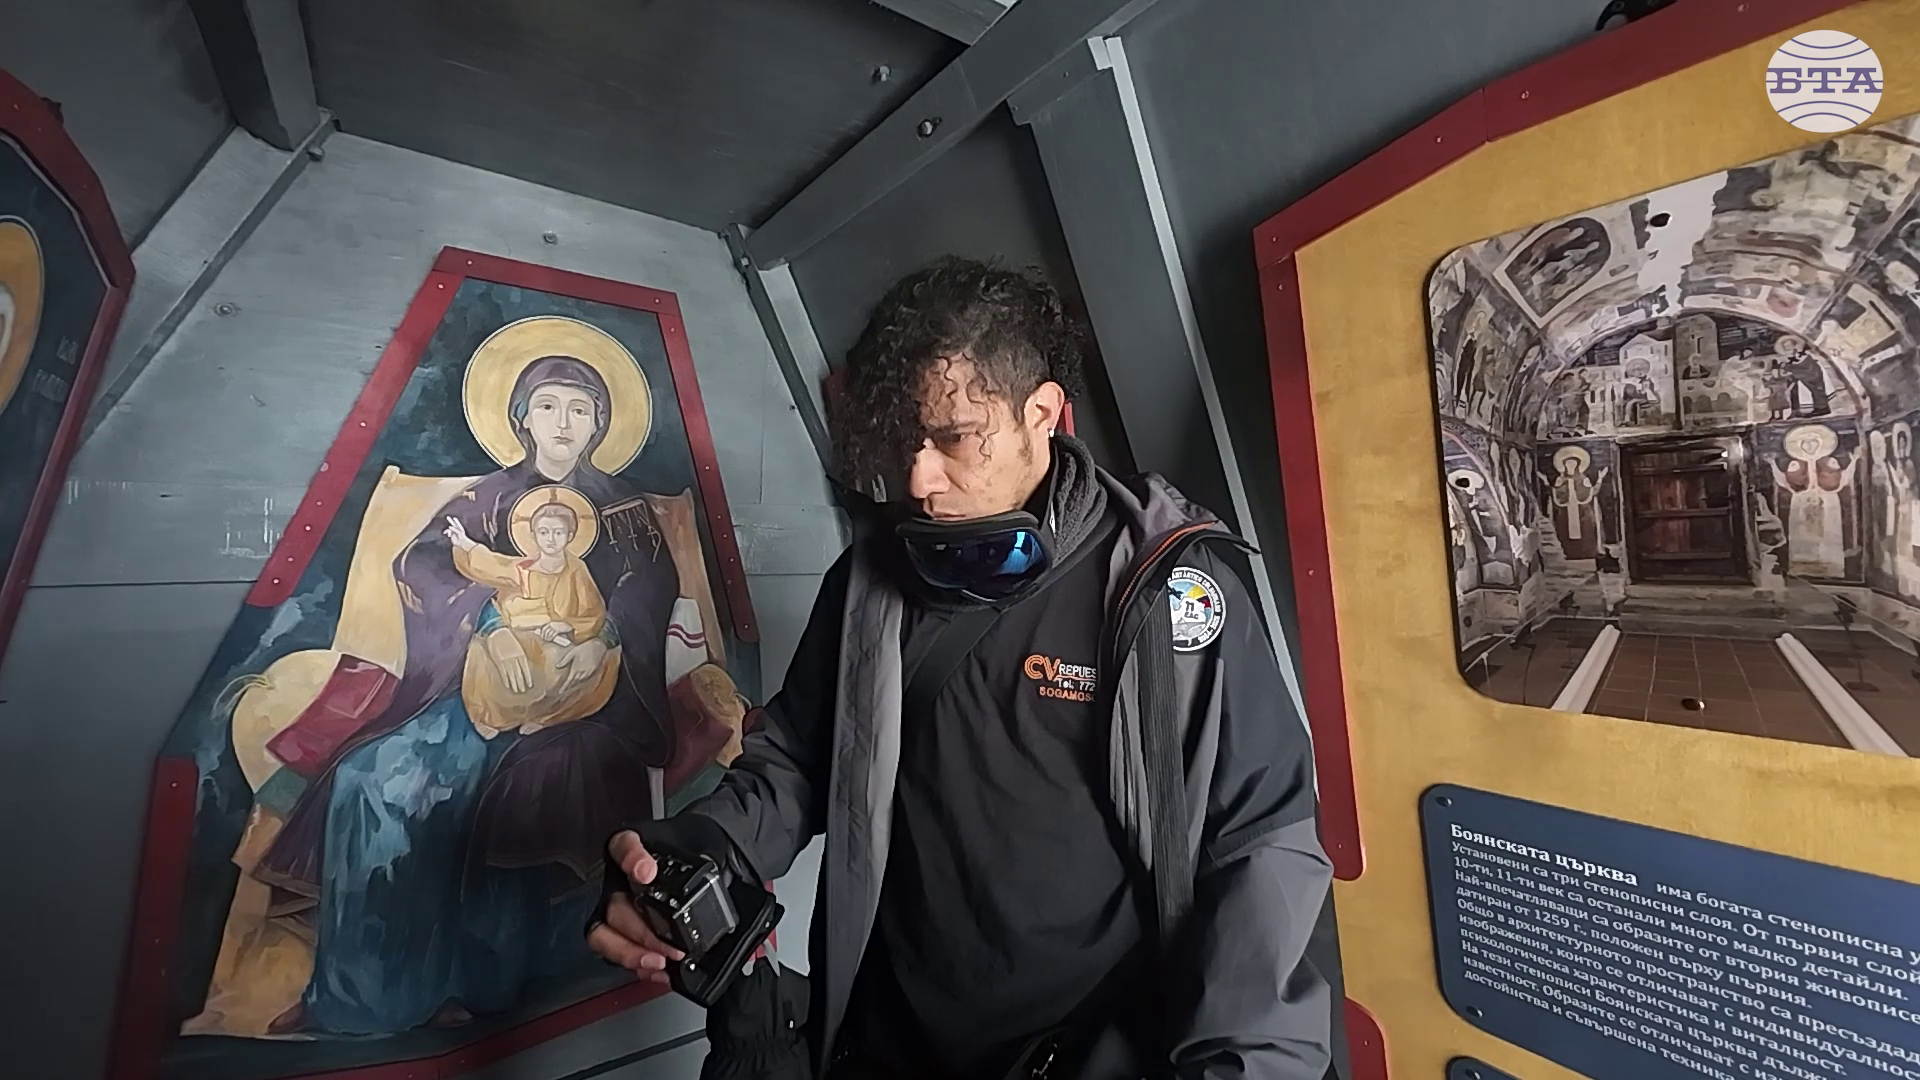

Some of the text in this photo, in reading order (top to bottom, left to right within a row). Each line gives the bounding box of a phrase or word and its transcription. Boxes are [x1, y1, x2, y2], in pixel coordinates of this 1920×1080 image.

[1024, 654, 1060, 680] CV
[1451, 823, 1551, 863] Боянската
[1555, 854, 1638, 887] църква
[1656, 883, 1692, 901] има
[1696, 892, 1763, 920] богата
[1767, 913, 1903, 959] стенописна
[1451, 841, 1530, 873] Установени
[1533, 866, 1549, 878] са
[1551, 871, 1580, 888] три
[1583, 880, 1685, 917] стенописни
[1689, 910, 1738, 933] слоя.
[1742, 923, 1770, 940] От
[1775, 934, 1860, 968] първия
[1455, 870, 1589, 921] Най-впечатляващи
[1592, 914, 1610, 927] са
[1612, 921, 1695, 953] образите
[1698, 947, 1721, 961] от
[1725, 955, 1800, 986] втория
[1456, 886, 1512, 910] датиран
[1513, 904, 1531, 916] от
[1534, 909, 1570, 929] 1259
[1590, 929, 1664, 960] положен
[1668, 954, 1724, 981] върху
[1728, 973, 1813, 1009] първия.
[1497, 868, 1535, 889] 11-ти
[1538, 882, 1565, 898] век
[1567, 891, 1584, 903] са
[1587, 897, 1666, 928] останали
[1670, 921, 1728, 947] много
[1733, 940, 1799, 967] малко
[1802, 961, 1910, 1001] детайли.
[1457, 898, 1495, 919] Общо
[1497, 912, 1506, 923] в
[1507, 918, 1632, 965] архитектурното
[1635, 959, 1766, 1011] пространство
[1770, 1005, 1792, 1020] са
[1460, 928, 1848, 1077] психологическа характеристика и виталност.
[1461, 940, 1828, 1080] На тези стенописи Боянската църква дълж
[1463, 956, 1540, 992] известност.
[1542, 985, 1616, 1021] Образите
[1618, 1016, 1637, 1030] се
[1640, 1024, 1735, 1068] отличават
[1739, 1063, 1750, 1074] с
[1556, 947, 1603, 971] които
[1605, 965, 1624, 978] се
[1626, 972, 1720, 1012] отличават
[1724, 1006, 1735, 1017] с
[1739, 1011, 1920, 1080] индивидуалнос
[1464, 970, 1736, 1080] достойнства и съвършена техника
